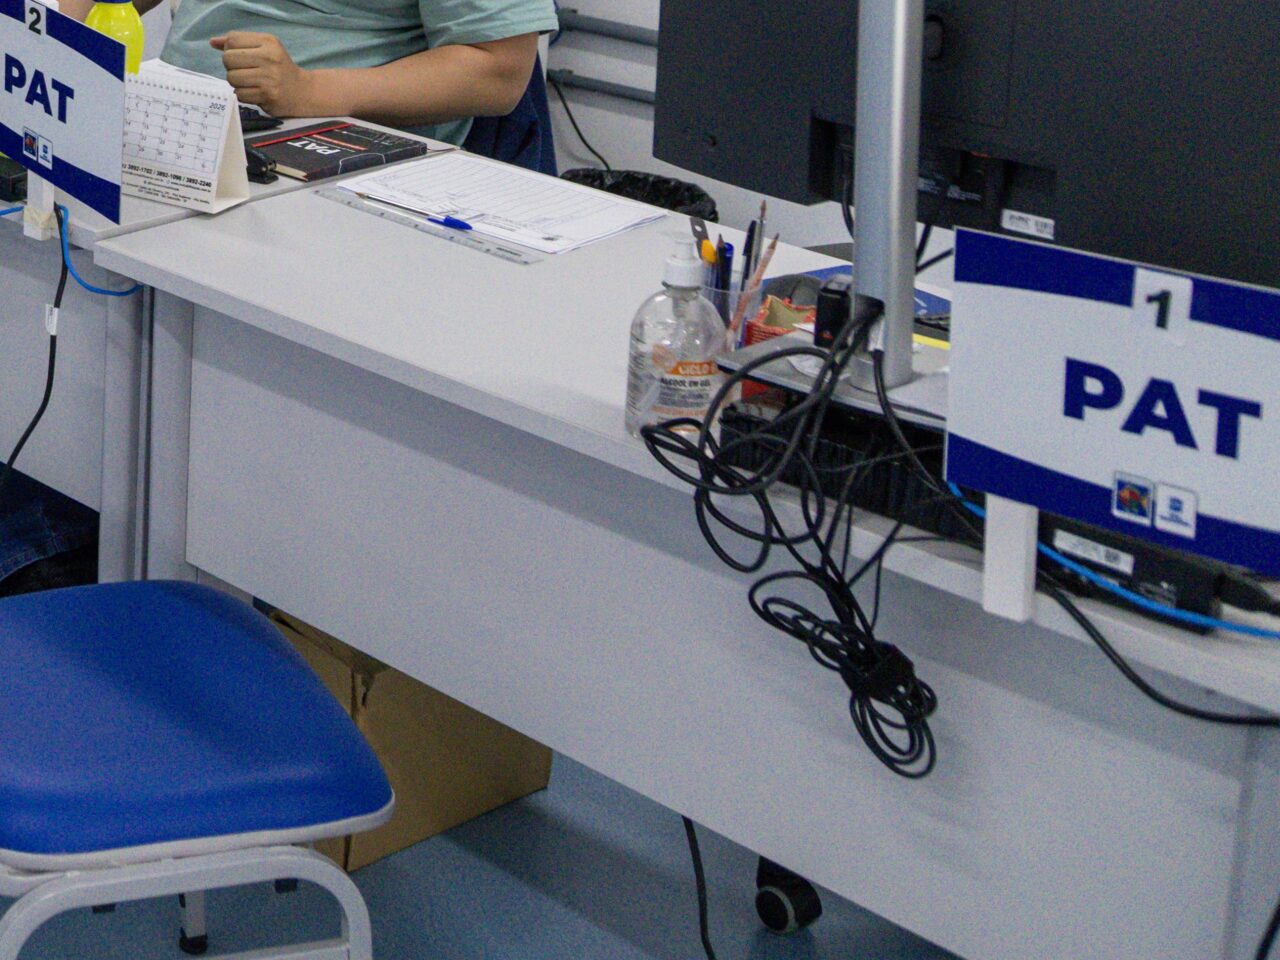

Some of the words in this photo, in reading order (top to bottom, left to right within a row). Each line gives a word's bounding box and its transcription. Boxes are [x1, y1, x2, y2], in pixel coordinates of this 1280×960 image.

[27, 7, 42, 35] 2
[4, 53, 75, 124] PAT
[286, 140, 341, 155] PAT
[1146, 290, 1172, 330] 1
[1063, 356, 1262, 460] PAT
